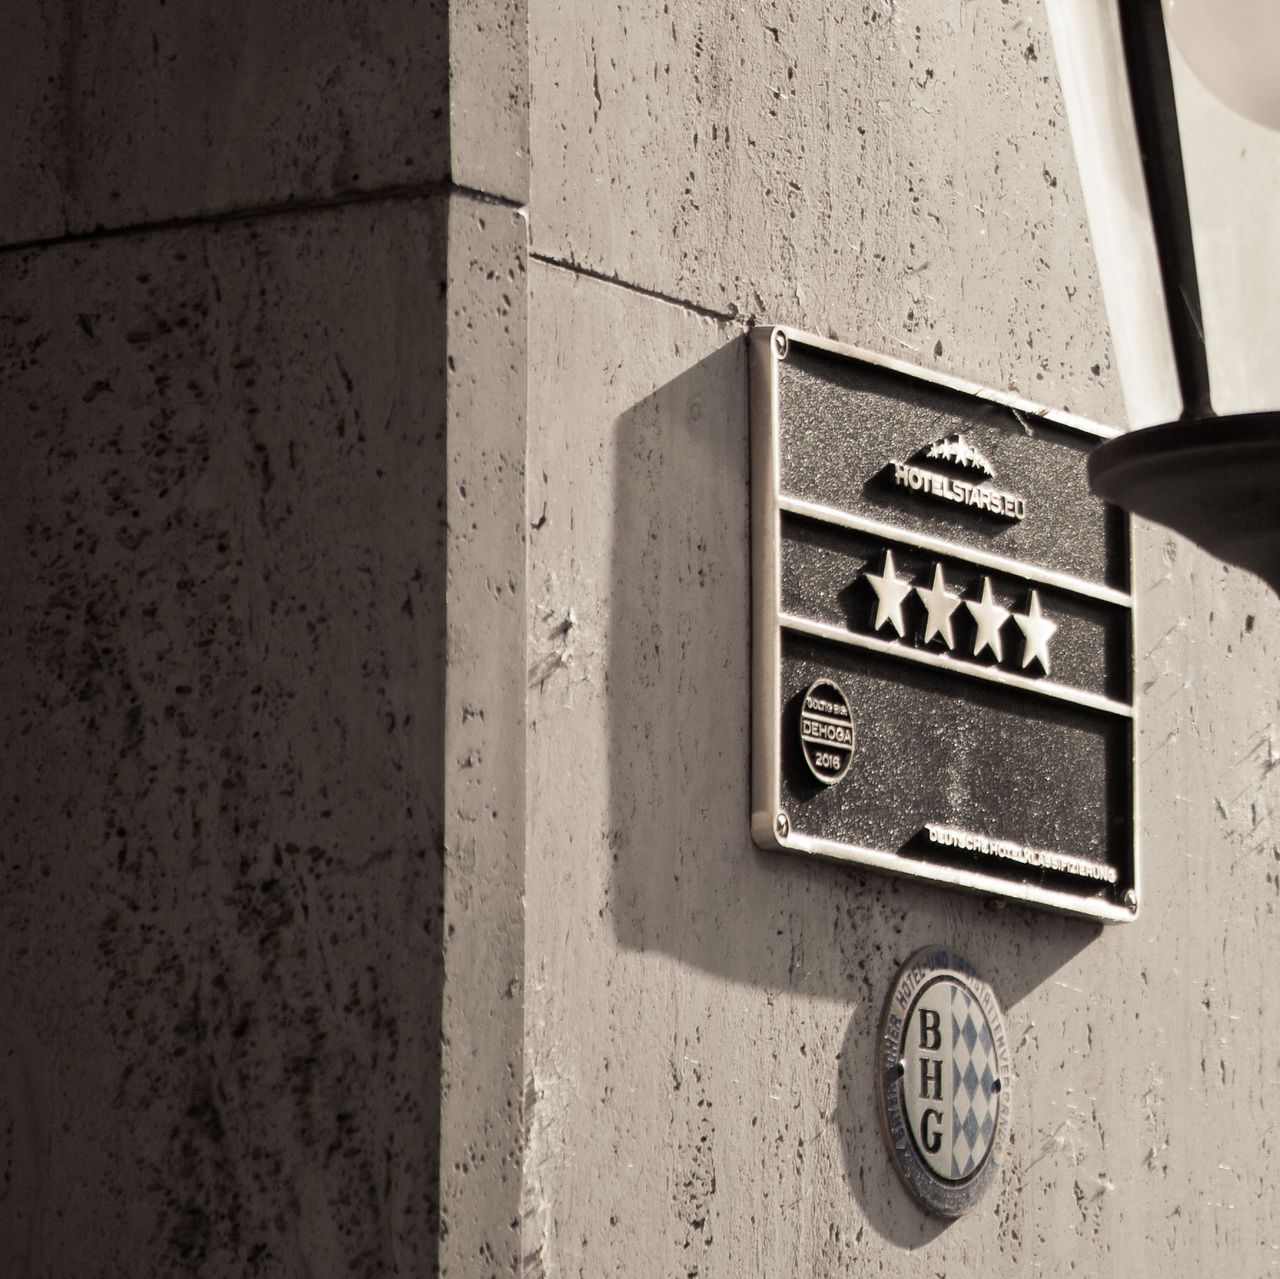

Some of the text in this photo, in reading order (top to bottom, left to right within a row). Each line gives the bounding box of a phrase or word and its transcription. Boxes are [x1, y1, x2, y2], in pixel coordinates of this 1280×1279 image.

[894, 462, 1026, 520] HOTELSTARS.EU
[803, 720, 852, 744] DEHOGA
[815, 752, 841, 770] 2016
[928, 825, 989, 855] DEUTSCHE
